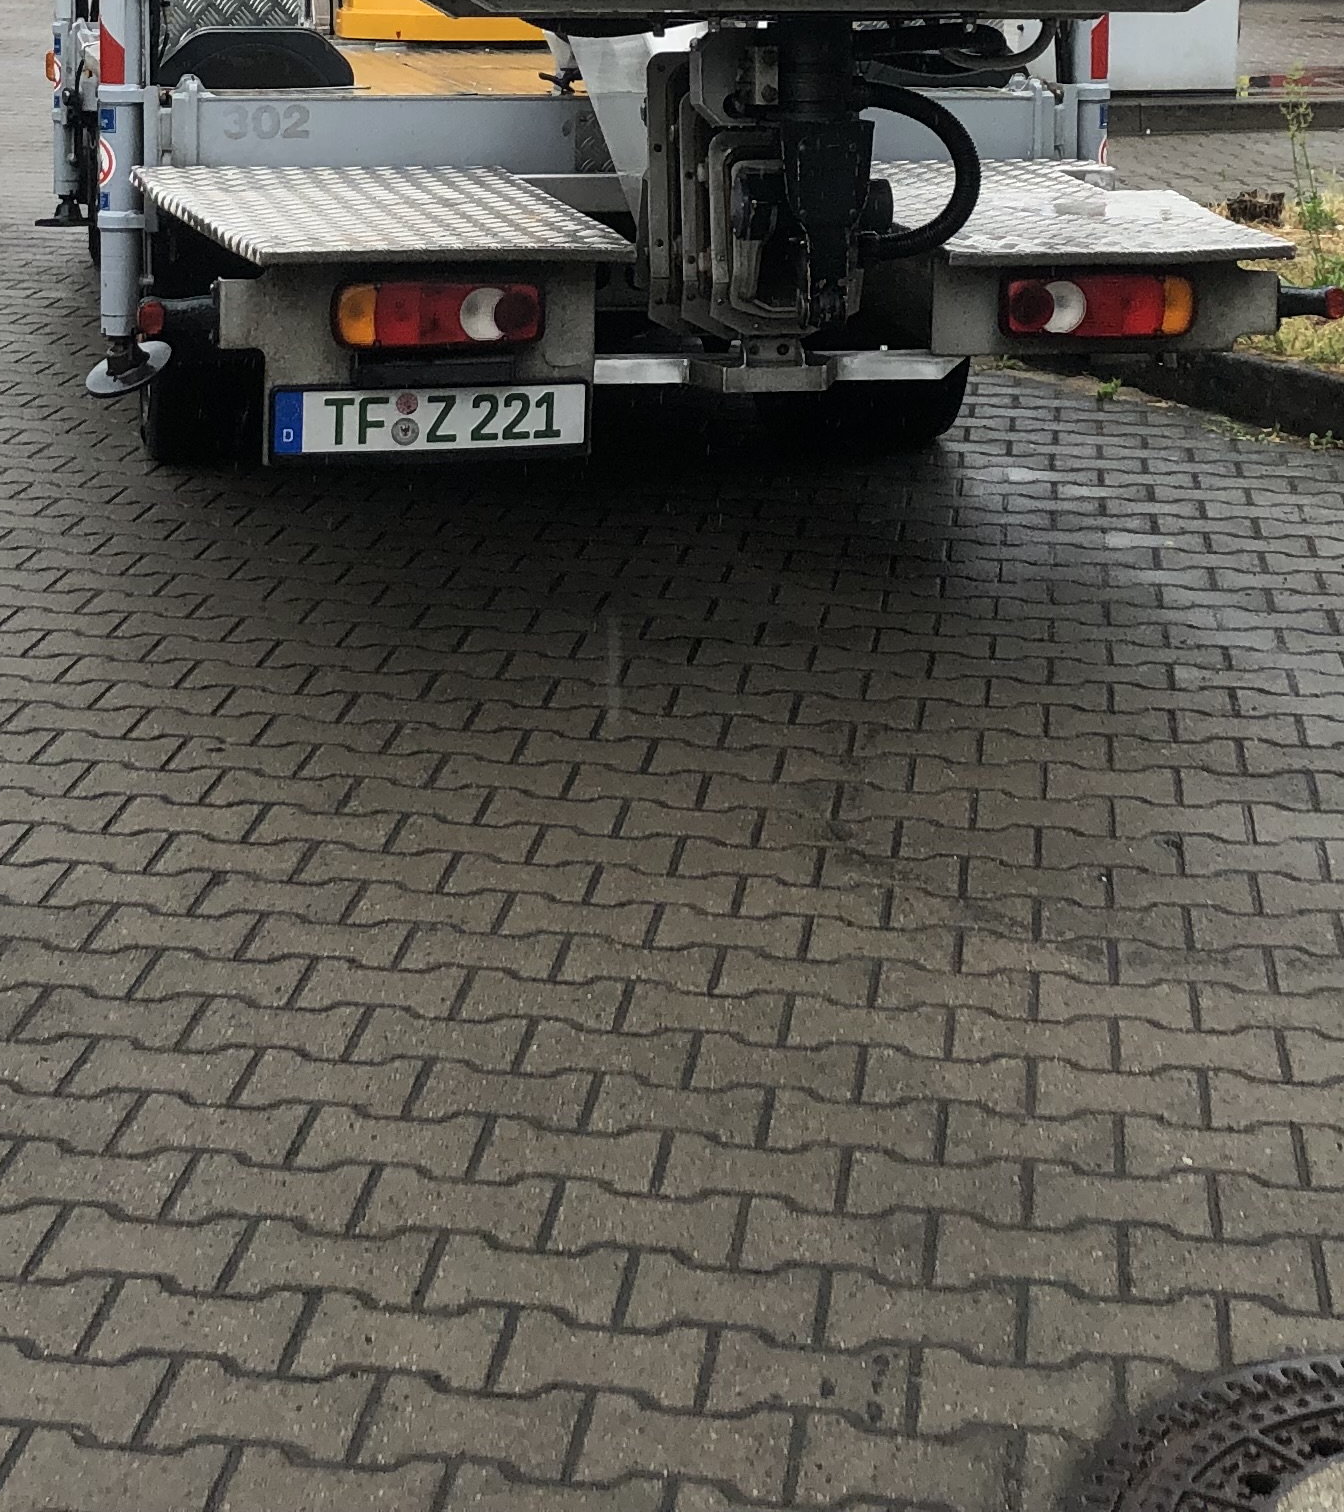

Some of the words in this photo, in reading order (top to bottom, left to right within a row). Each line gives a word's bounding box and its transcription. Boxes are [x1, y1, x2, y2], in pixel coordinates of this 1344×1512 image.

[222, 104, 310, 140] 302
[282, 428, 294, 443] D
[324, 396, 390, 445] TF
[426, 394, 457, 443] Z
[471, 391, 561, 441] 221
